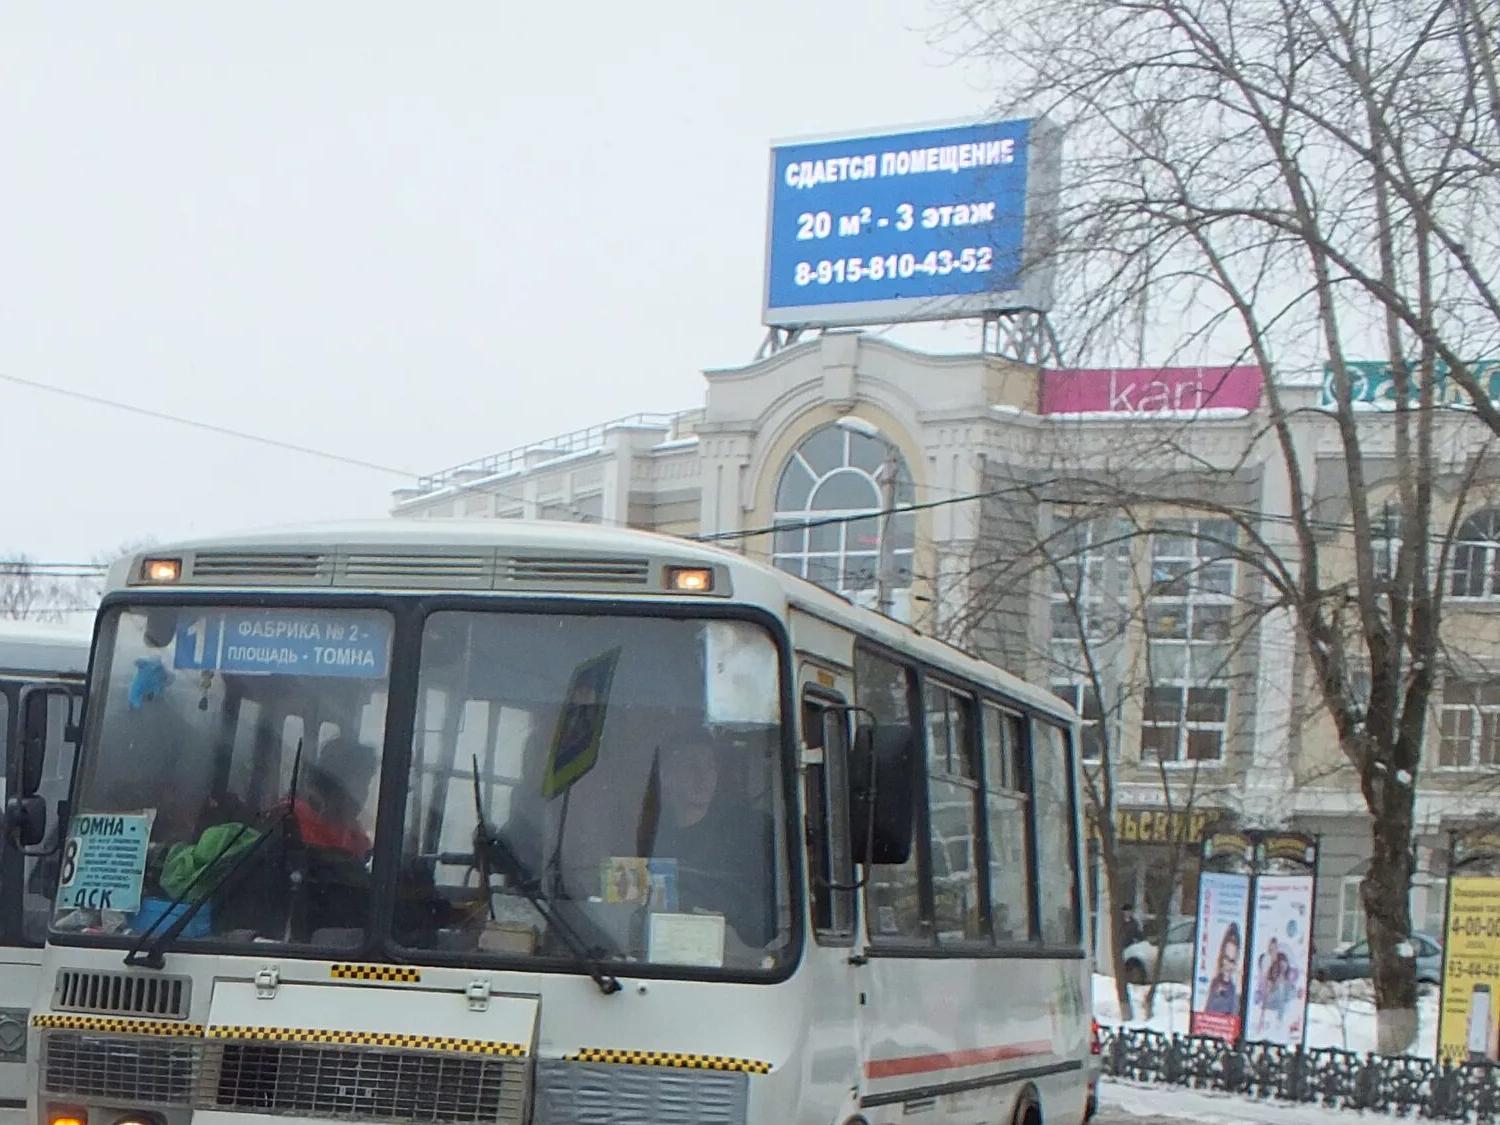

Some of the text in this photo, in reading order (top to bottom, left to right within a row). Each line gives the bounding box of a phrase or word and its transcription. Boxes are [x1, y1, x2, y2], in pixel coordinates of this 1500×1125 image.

[785, 139, 1014, 188] СДАЕТСЯ ПОМЕЩЕНИЕ
[797, 211, 832, 240] 20
[896, 203, 914, 232] 3
[922, 202, 996, 230] этаж
[794, 246, 993, 286] 8-915-810-43-52
[1109, 366, 1204, 413] kari
[187, 617, 206, 664] 1
[238, 619, 321, 641] ФАБРИКА
[227, 645, 298, 664] ПЛОЩАДЬ
[314, 646, 376, 668] ТОМНА
[74, 888, 113, 908] ДСК
